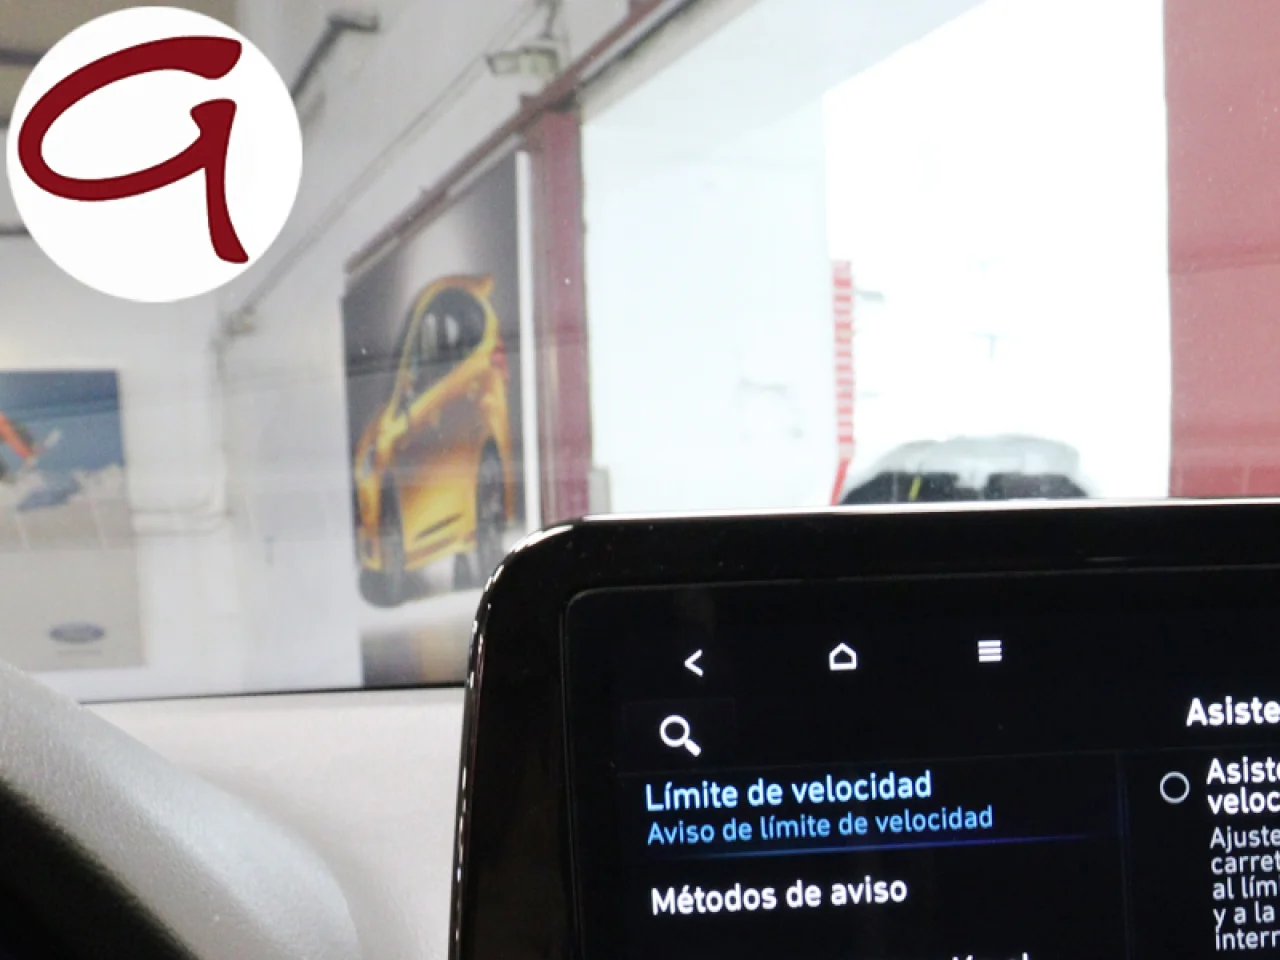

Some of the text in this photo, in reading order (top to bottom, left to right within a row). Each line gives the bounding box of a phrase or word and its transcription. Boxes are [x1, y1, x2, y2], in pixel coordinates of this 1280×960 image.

[646, 770, 931, 811] Límite de velocidad
[648, 806, 993, 845] Aviso de límite de velocidad
[651, 876, 907, 915] Métodos de aviso
[1213, 880, 1234, 900] al
[1213, 907, 1226, 929] y
[1233, 907, 1246, 923] a
[1254, 902, 1275, 922] la
